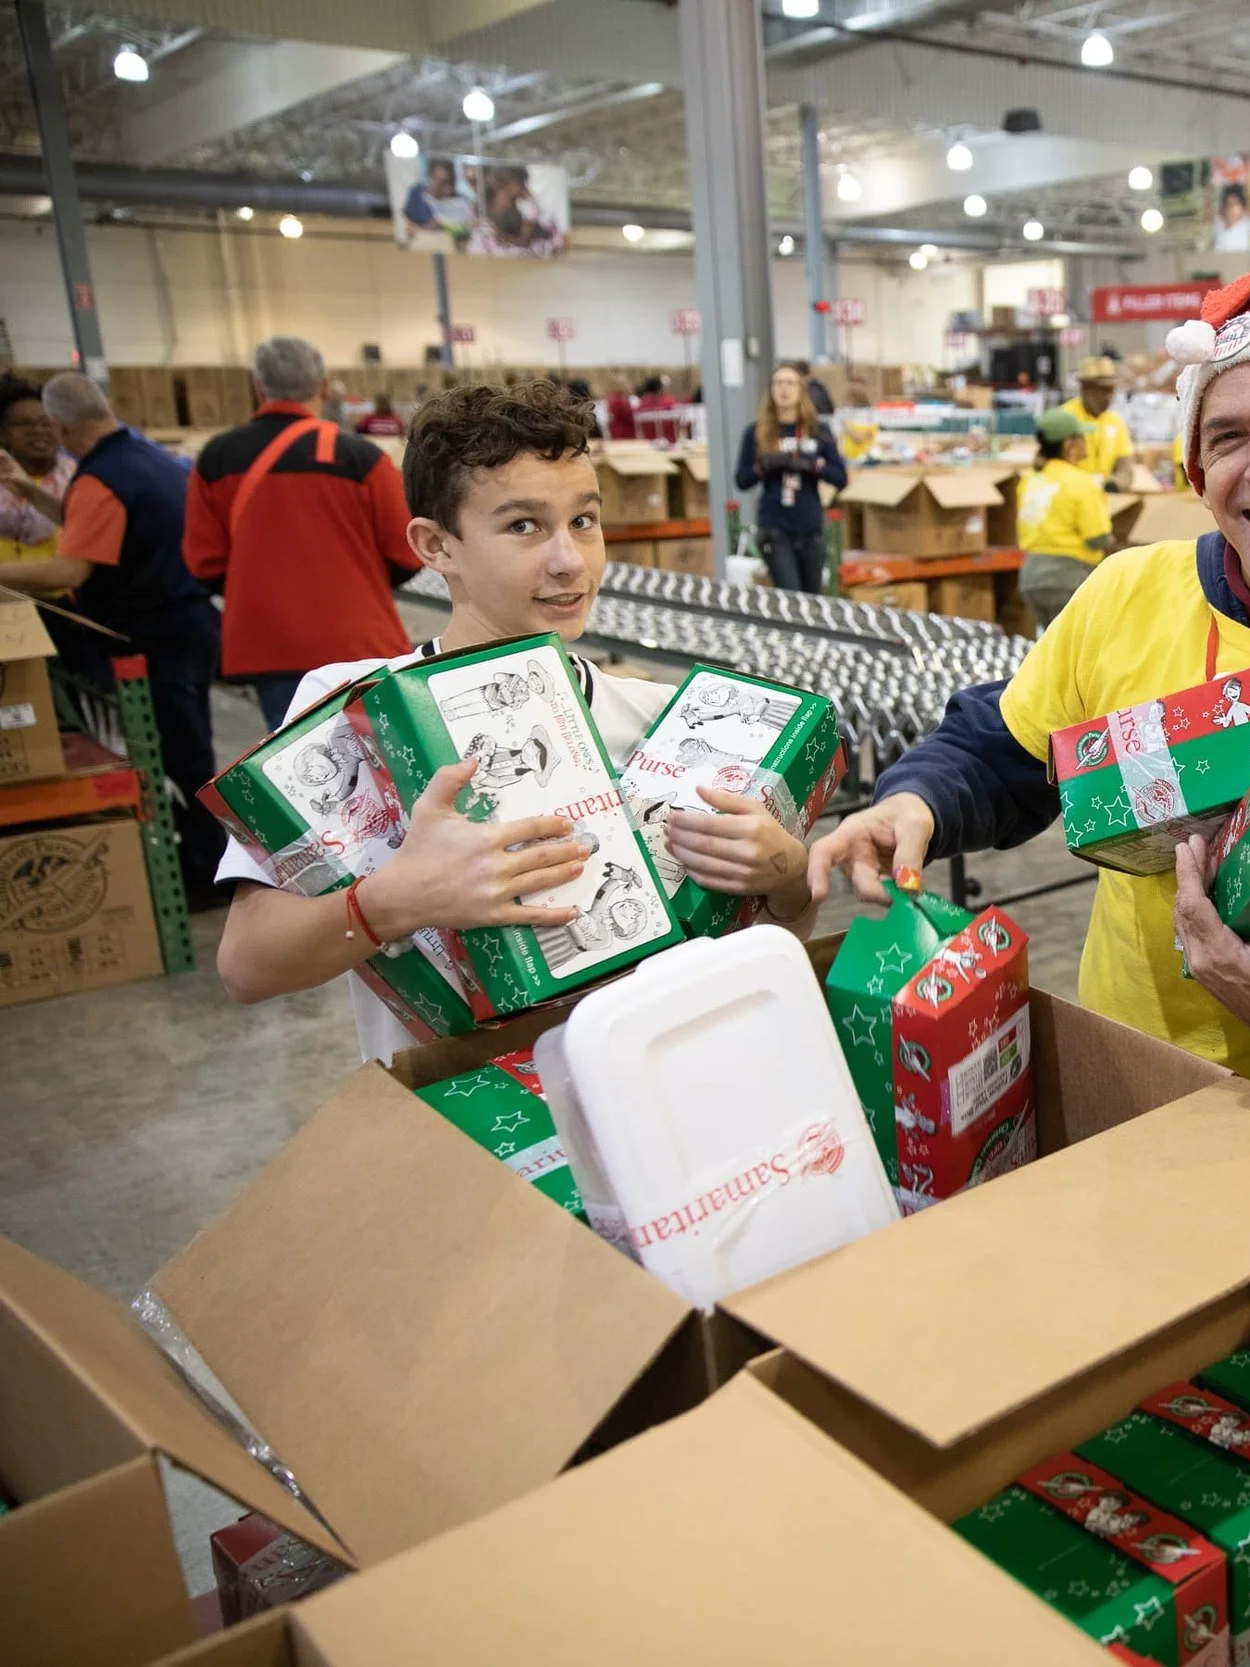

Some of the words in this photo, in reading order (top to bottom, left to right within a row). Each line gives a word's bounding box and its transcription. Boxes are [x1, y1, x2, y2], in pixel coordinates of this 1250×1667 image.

[1115, 706, 1142, 755] urse
[625, 751, 686, 779] Purse
[770, 736, 793, 770] nstructions
[554, 790, 624, 822] ritans
